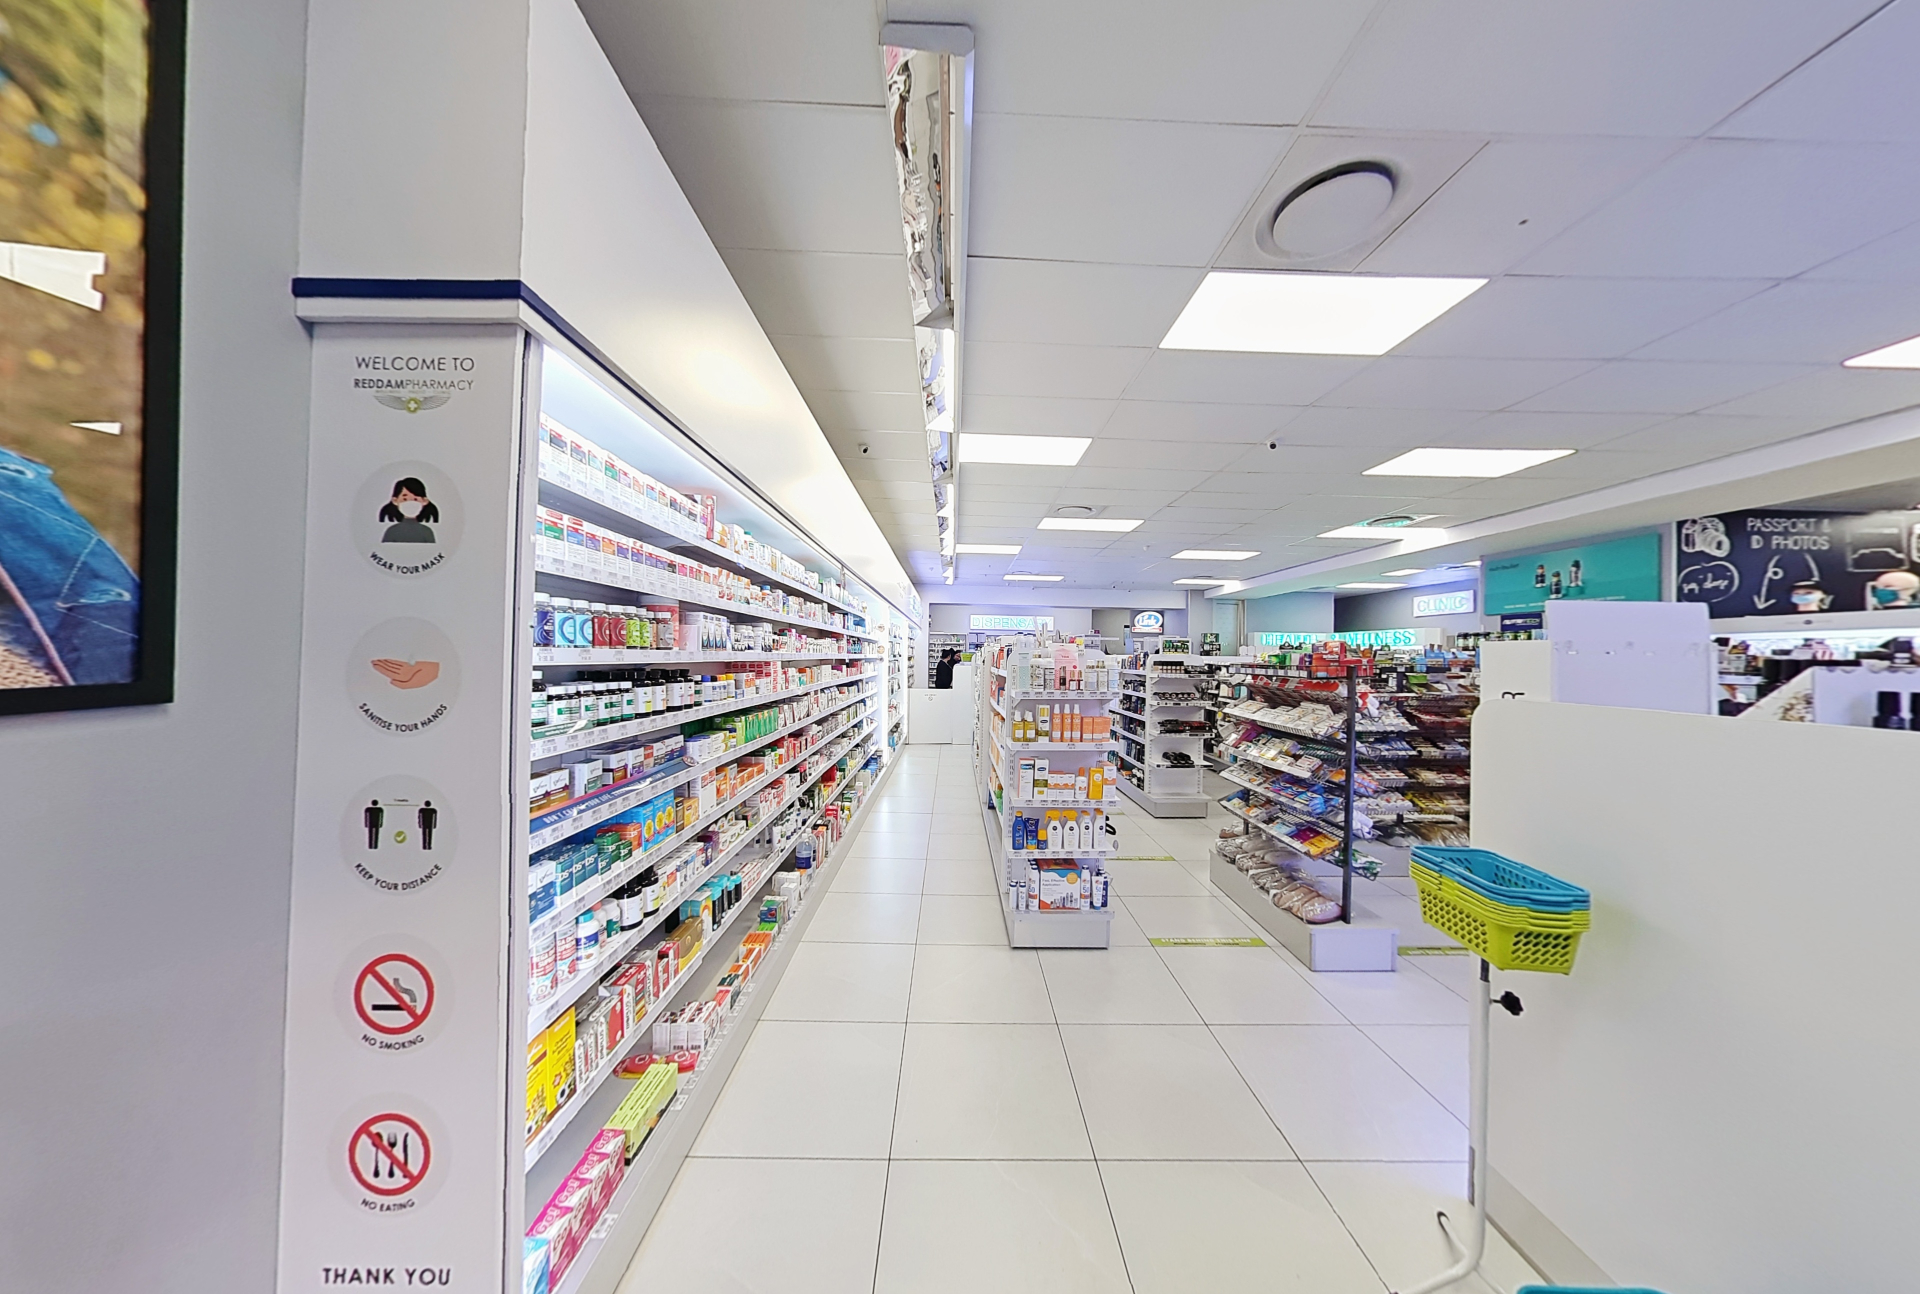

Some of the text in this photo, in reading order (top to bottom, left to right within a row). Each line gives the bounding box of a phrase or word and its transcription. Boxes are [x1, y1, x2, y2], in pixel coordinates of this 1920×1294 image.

[355, 356, 475, 372] WELCOME TO
[354, 378, 474, 391] REDDAMPHARMACY
[1746, 517, 1818, 532] PASSPORT
[1771, 535, 1830, 550] PHOTOS
[370, 552, 445, 574] WEAR YOUR MASK
[1417, 596, 1468, 613] CLINIC
[972, 616, 1054, 629] DISPENSARY
[1343, 630, 1416, 647] WELLNESS
[359, 702, 447, 732] SANITISE YOUR HANDS
[354, 862, 442, 891] KEEP YOUR DISTANCE
[361, 1033, 425, 1050] NO SMOKING
[361, 1198, 415, 1212] NO EATING
[322, 1267, 451, 1286] THANK YOU
